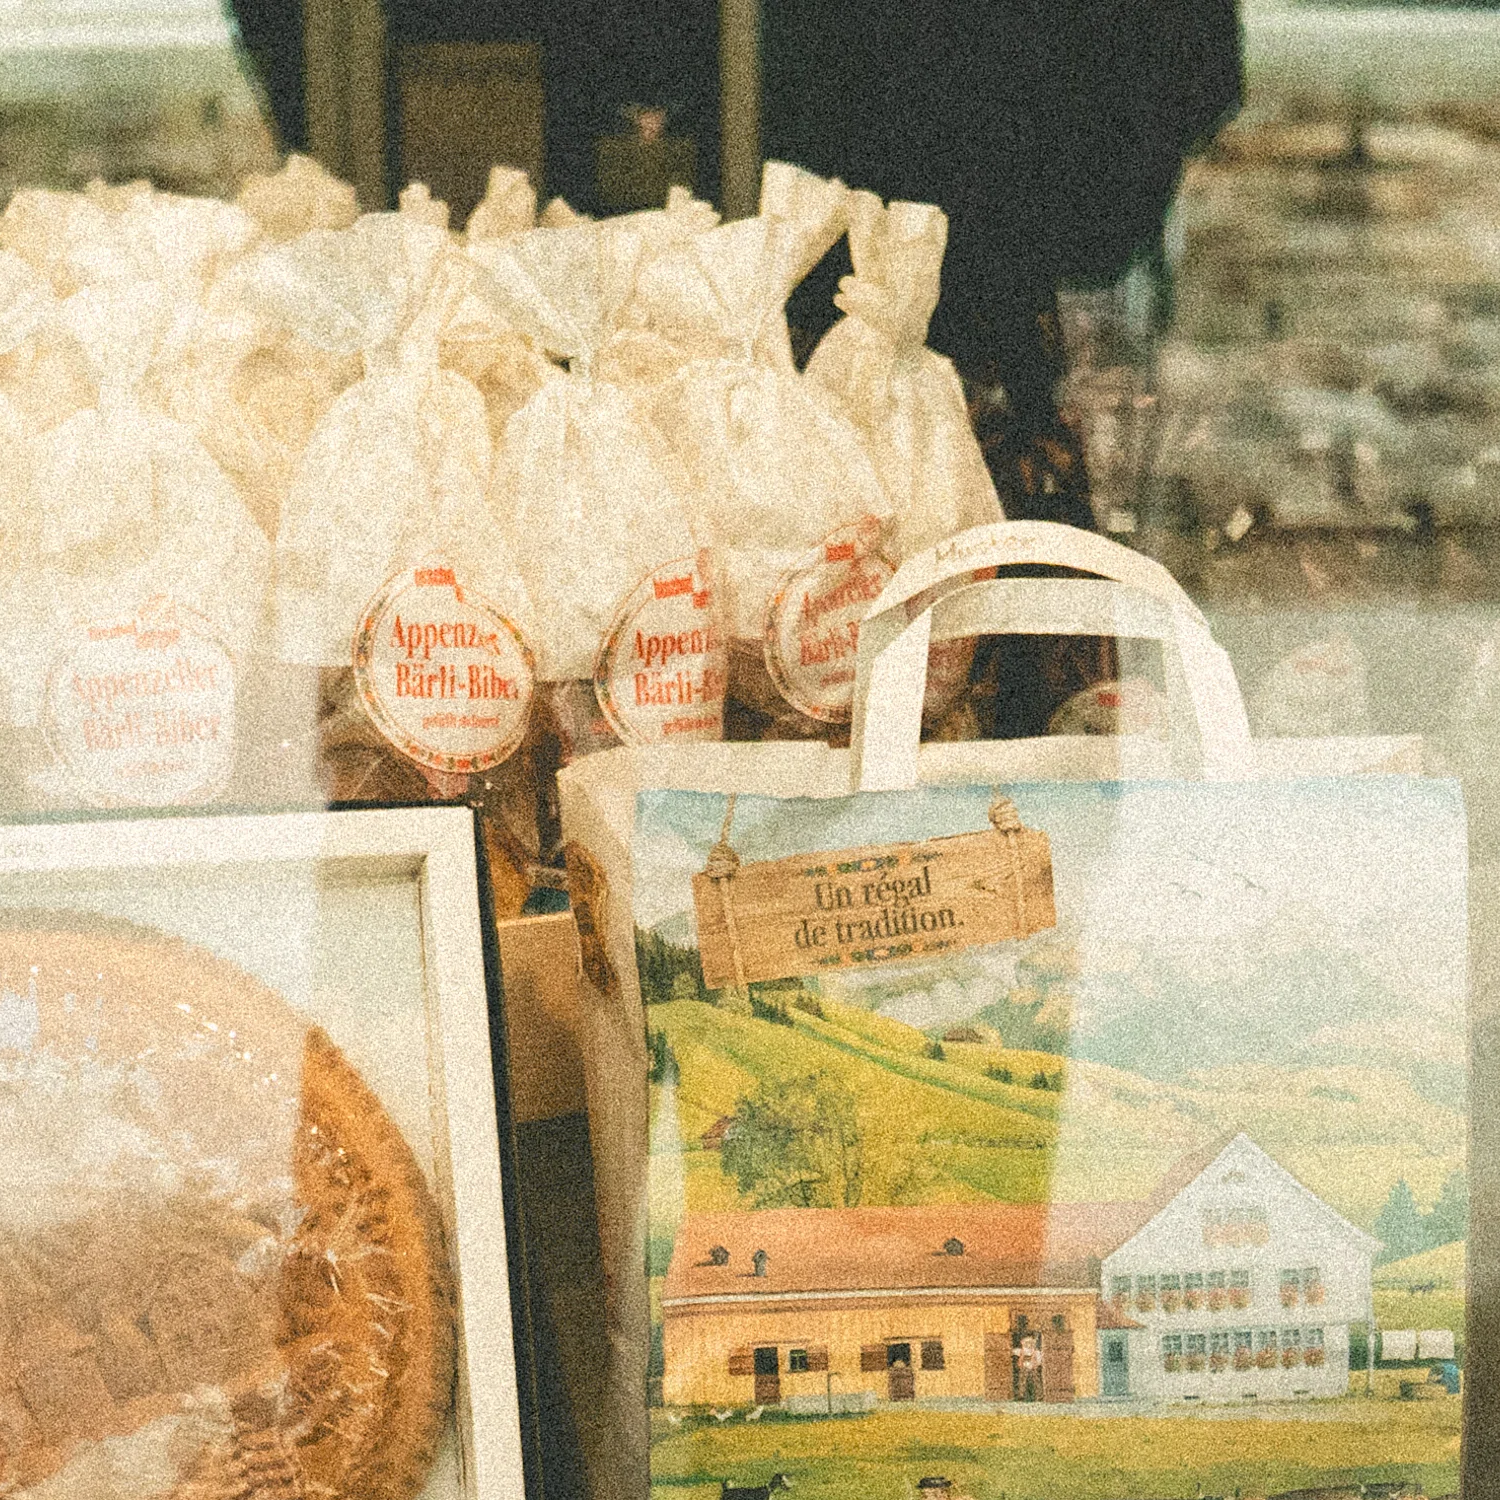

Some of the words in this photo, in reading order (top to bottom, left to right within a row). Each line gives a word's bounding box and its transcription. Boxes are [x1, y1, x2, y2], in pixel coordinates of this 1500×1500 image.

[814, 881, 853, 911] Un
[862, 865, 932, 907] régal
[794, 918, 828, 949] de
[835, 906, 966, 945] tradition.
